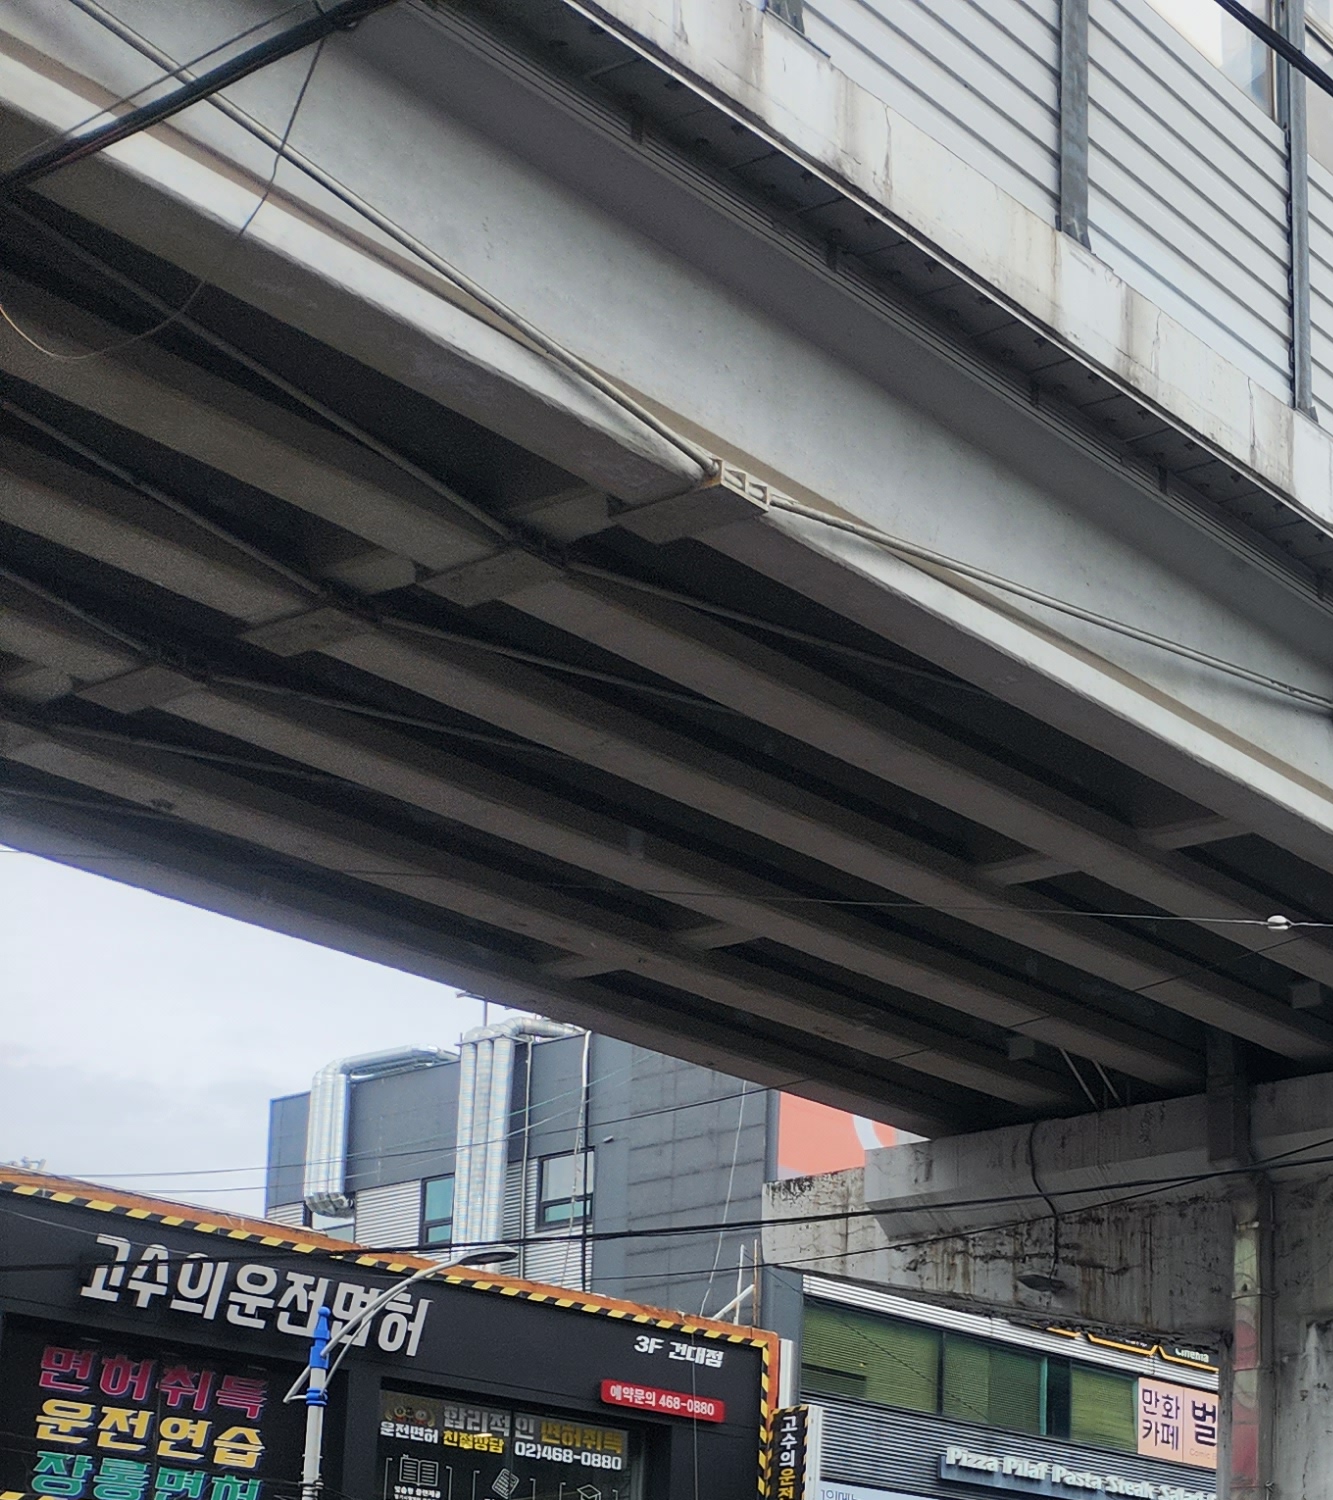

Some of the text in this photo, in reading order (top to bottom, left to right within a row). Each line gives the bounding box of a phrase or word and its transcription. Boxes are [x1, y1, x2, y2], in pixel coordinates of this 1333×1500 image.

[633, 1335, 725, 1369] 3F 건대점
[38, 1346, 269, 1418] 면허취득
[610, 1384, 715, 1416] 예약문의 468-0880
[1142, 1388, 1180, 1421] 만화
[36, 1399, 266, 1470] 운전연습
[380, 1421, 439, 1444] 운전면허
[1142, 1419, 1180, 1451] 카페
[514, 1441, 622, 1471] 02)468-0880
